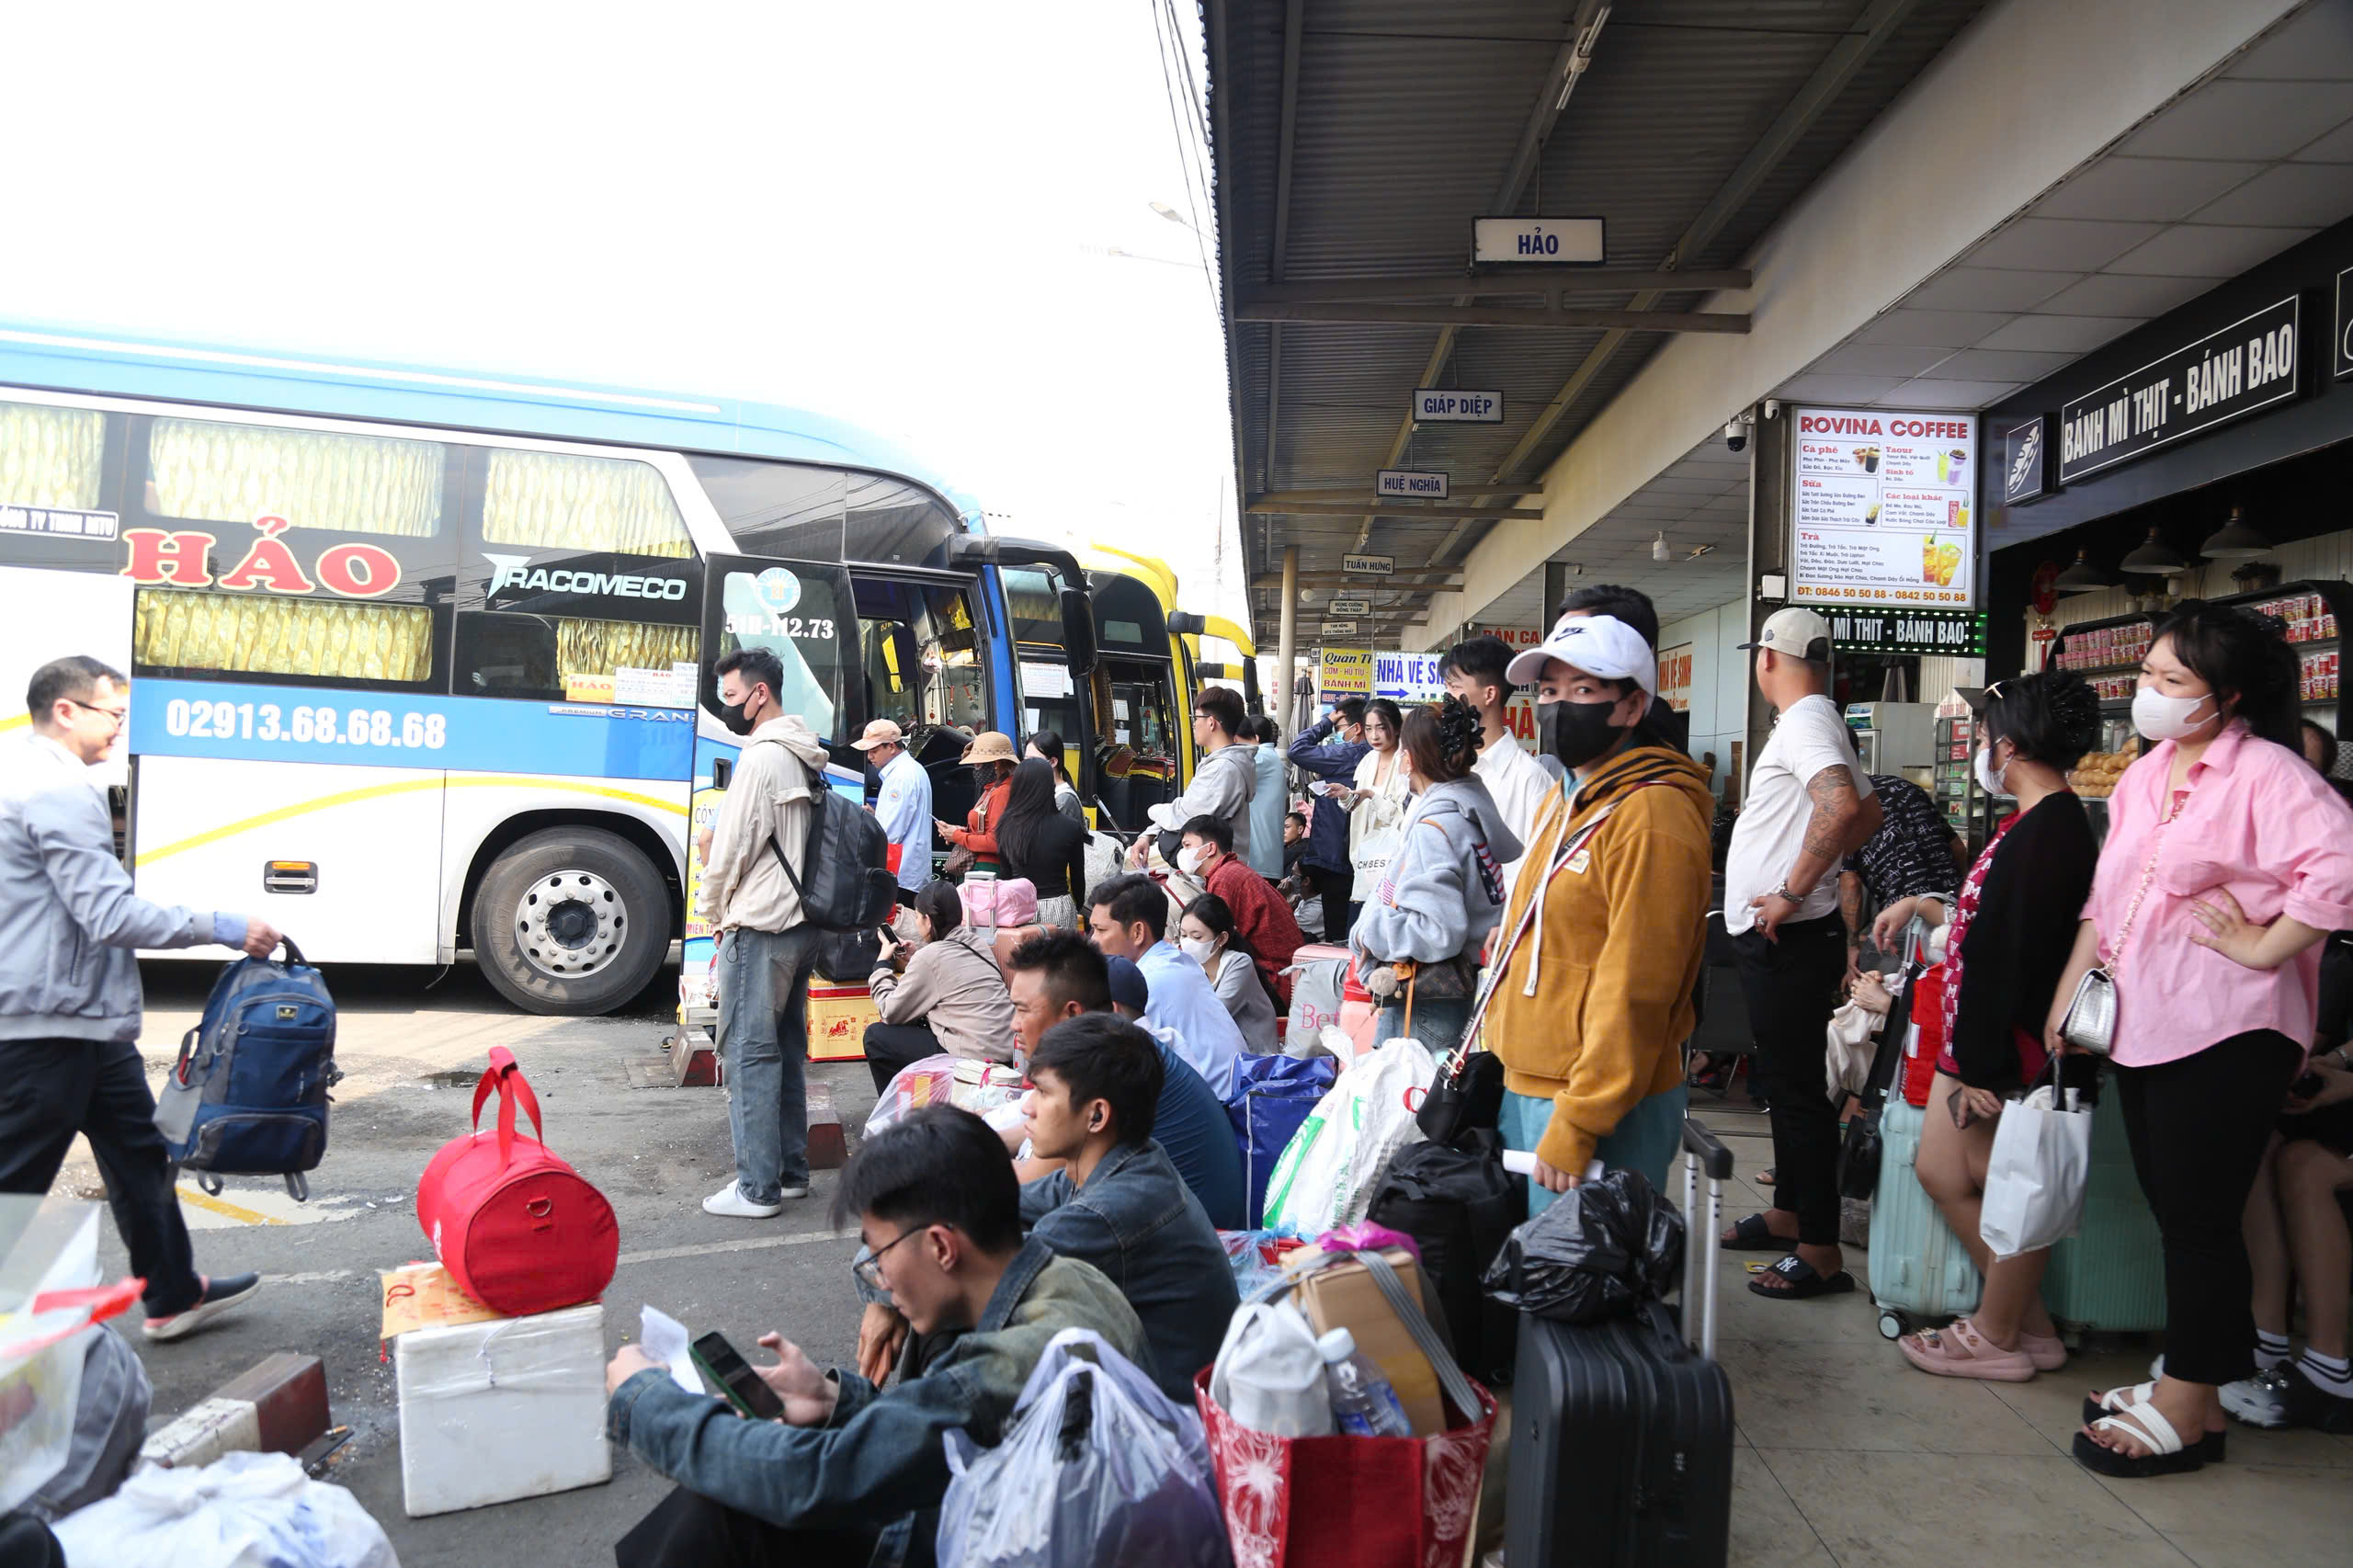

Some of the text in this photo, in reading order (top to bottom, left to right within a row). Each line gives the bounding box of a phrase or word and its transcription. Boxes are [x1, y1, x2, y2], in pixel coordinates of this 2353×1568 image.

[1518, 227, 1559, 255] HẢO
[2064, 409, 2104, 464] BÁNH
[2108, 387, 2129, 447] MÌ
[2133, 378, 2169, 438] THỊT
[2187, 349, 2242, 415] BÁNH
[2247, 324, 2293, 390] BAO
[1424, 394, 1493, 417] GIÁP DIỆP
[1801, 416, 1968, 438] ROVINA COFFEE
[1802, 445, 1815, 453] Cà
[1384, 475, 1441, 493] HUỆ NGHĨA
[1802, 479, 1822, 488] Sữa
[1801, 532, 1820, 540] Trà
[119, 516, 402, 597] HẢO
[1346, 558, 1391, 572] TUẤN HƯNG
[480, 552, 688, 601] TRACOMECO
[1815, 587, 1840, 597] 0846
[1843, 588, 1856, 597] 50
[1859, 588, 1871, 597] 50
[1874, 589, 1886, 598] 88
[1895, 590, 1920, 600] 0842
[1923, 591, 1935, 600] 50
[1938, 592, 1950, 601] 50
[1954, 593, 1966, 602] 88
[1833, 612, 1851, 641] MÌ
[1854, 619, 1883, 645] THỊT
[1896, 616, 1934, 643] BÁNH
[1938, 621, 1965, 644] BAO
[1324, 652, 1357, 665] Quán
[1324, 666, 1338, 675] CƠM
[1377, 655, 1445, 688] NHÀ VỆ SI
[571, 679, 612, 691] HẢO
[1324, 679, 1366, 689] BÁNH MÌ
[166, 699, 446, 749] 02913.68.68.68
[1502, 699, 1536, 740] HÀ
